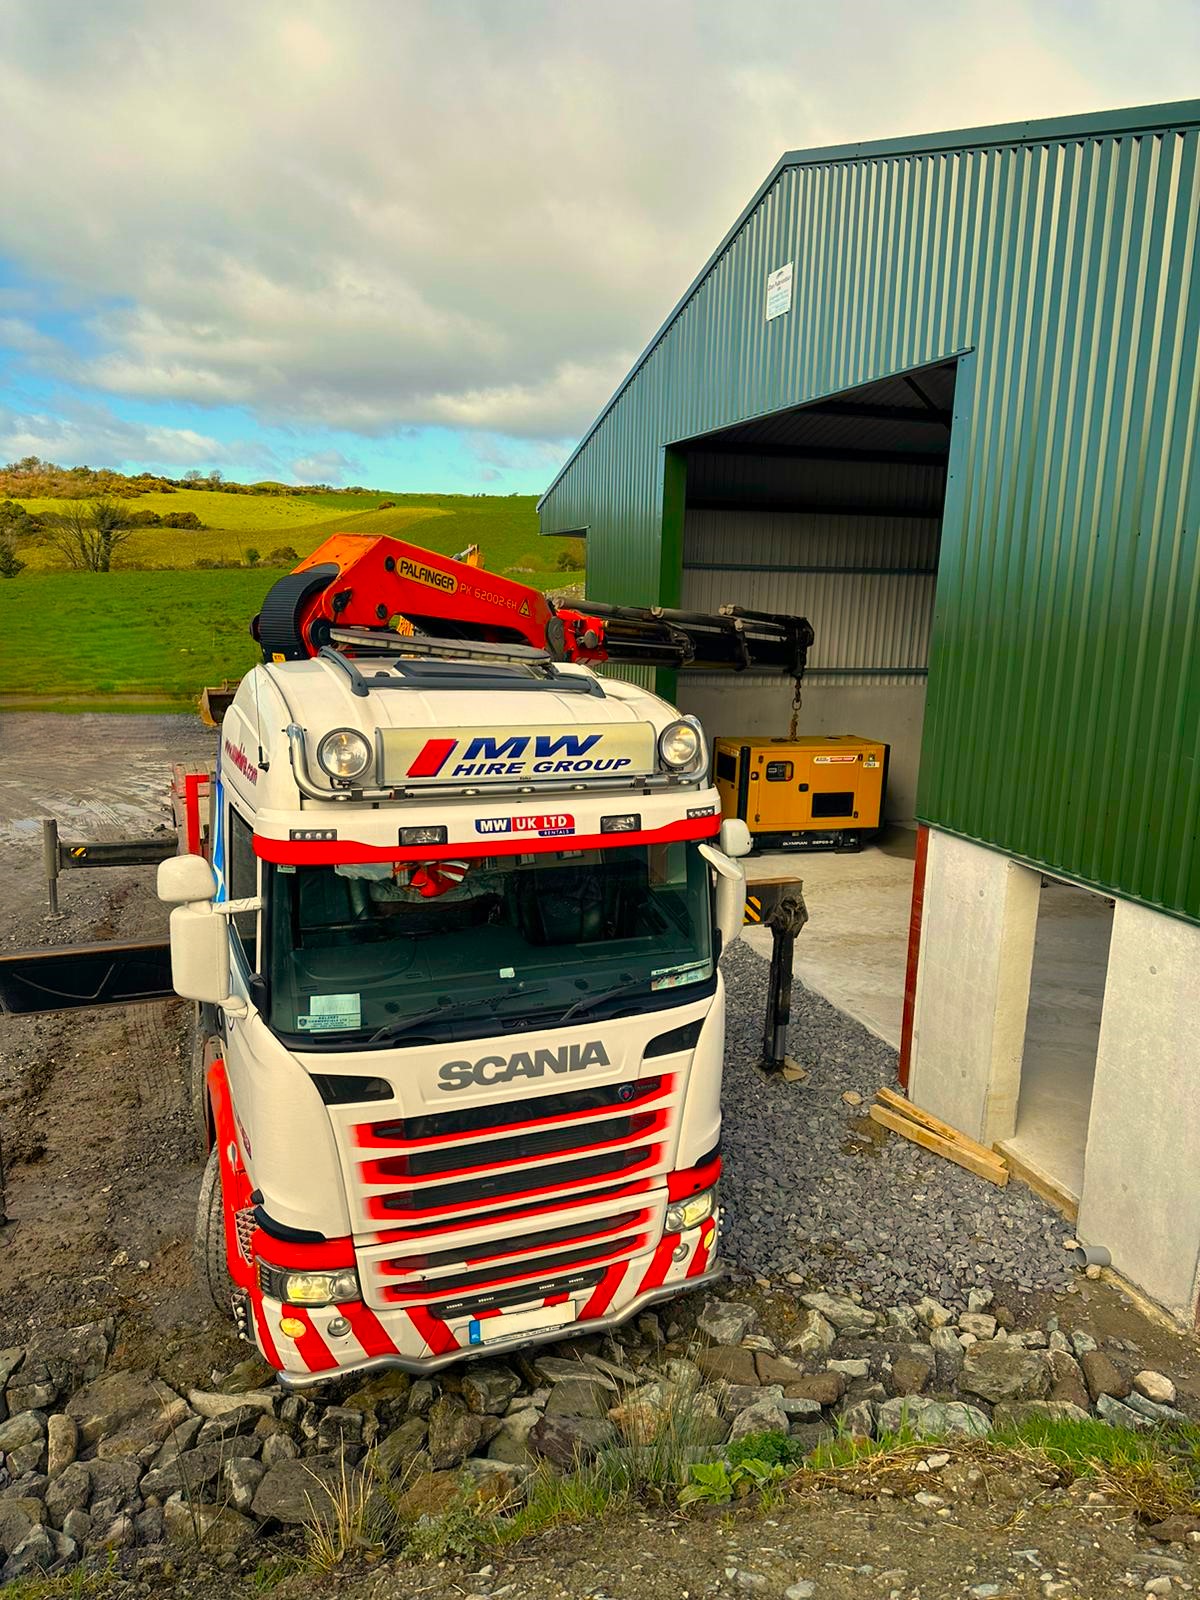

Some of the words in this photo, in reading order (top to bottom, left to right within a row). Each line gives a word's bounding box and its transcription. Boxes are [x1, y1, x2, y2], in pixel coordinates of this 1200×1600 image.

[399, 559, 455, 592] PALFINGER
[460, 582, 472, 595] PK
[462, 734, 603, 760] MW
[451, 761, 526, 777] HIRE
[532, 758, 632, 774] GROUP
[480, 819, 508, 832] MW
[515, 817, 537, 830] UK
[543, 815, 568, 828] LTD
[437, 1040, 611, 1092] SCANIA
